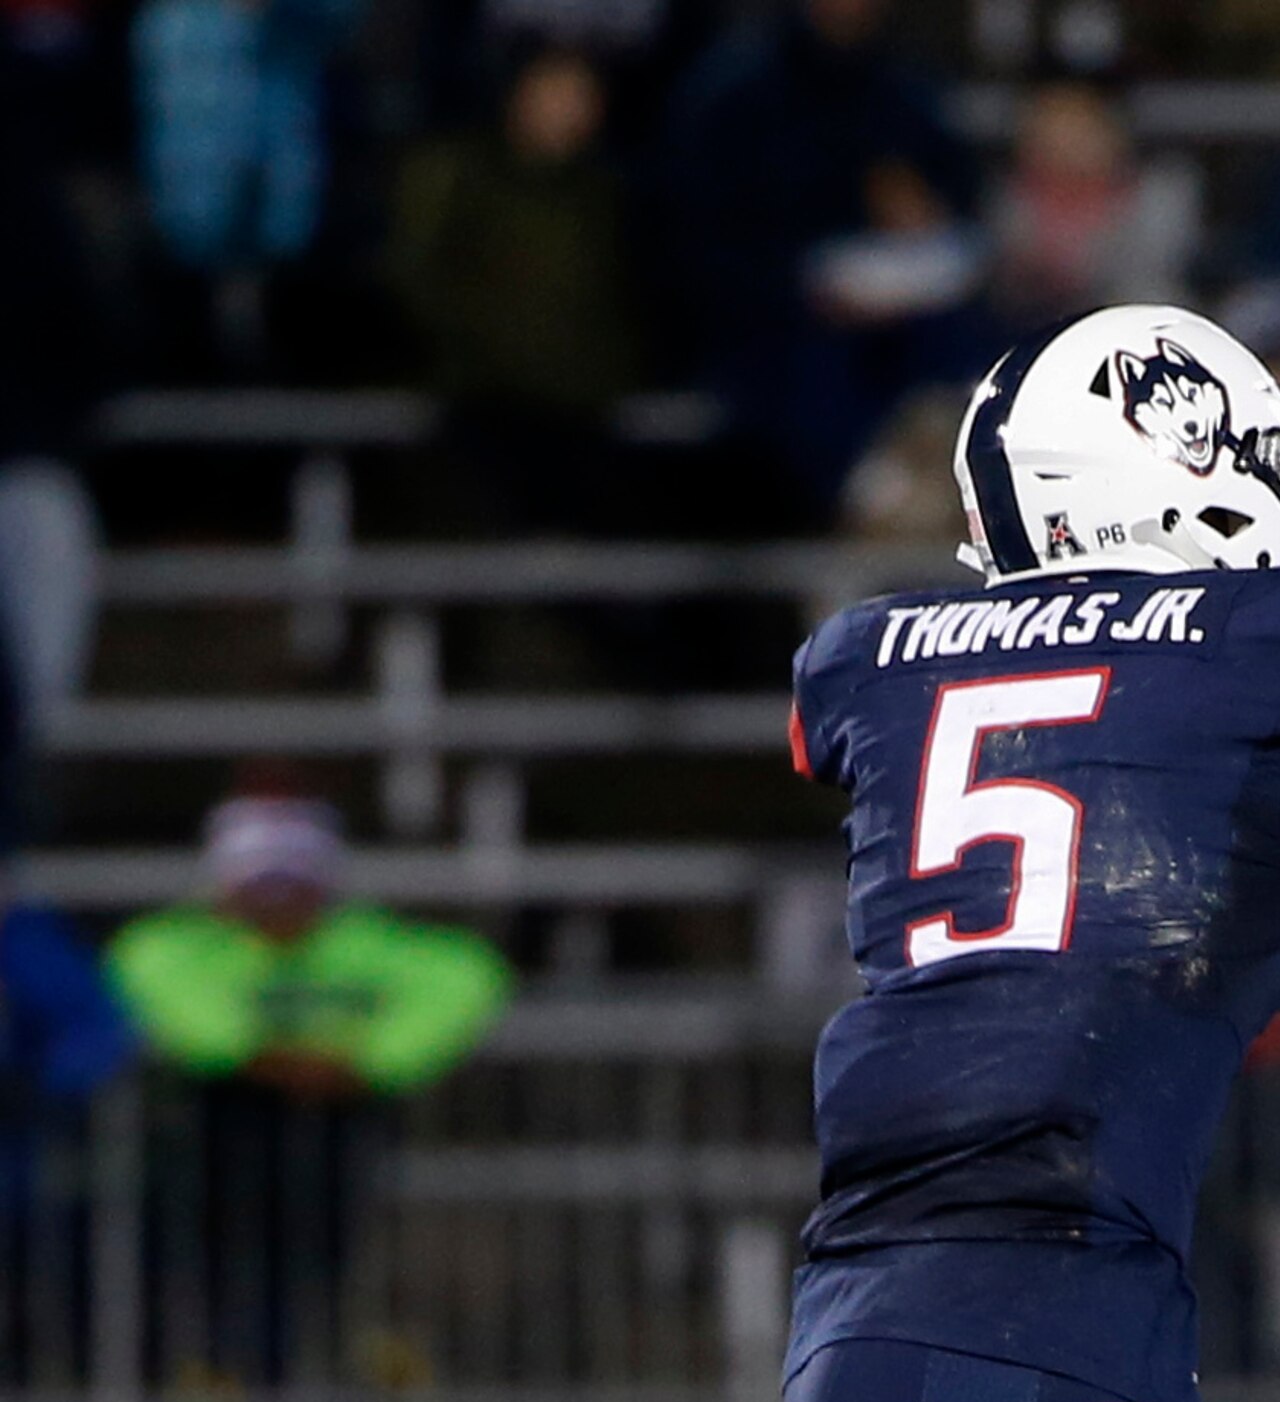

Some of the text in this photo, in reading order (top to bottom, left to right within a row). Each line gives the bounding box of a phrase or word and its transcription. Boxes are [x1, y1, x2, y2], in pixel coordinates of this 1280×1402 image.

[876, 588, 1206, 667] THOMAS JR.
[904, 665, 1112, 968] 5
